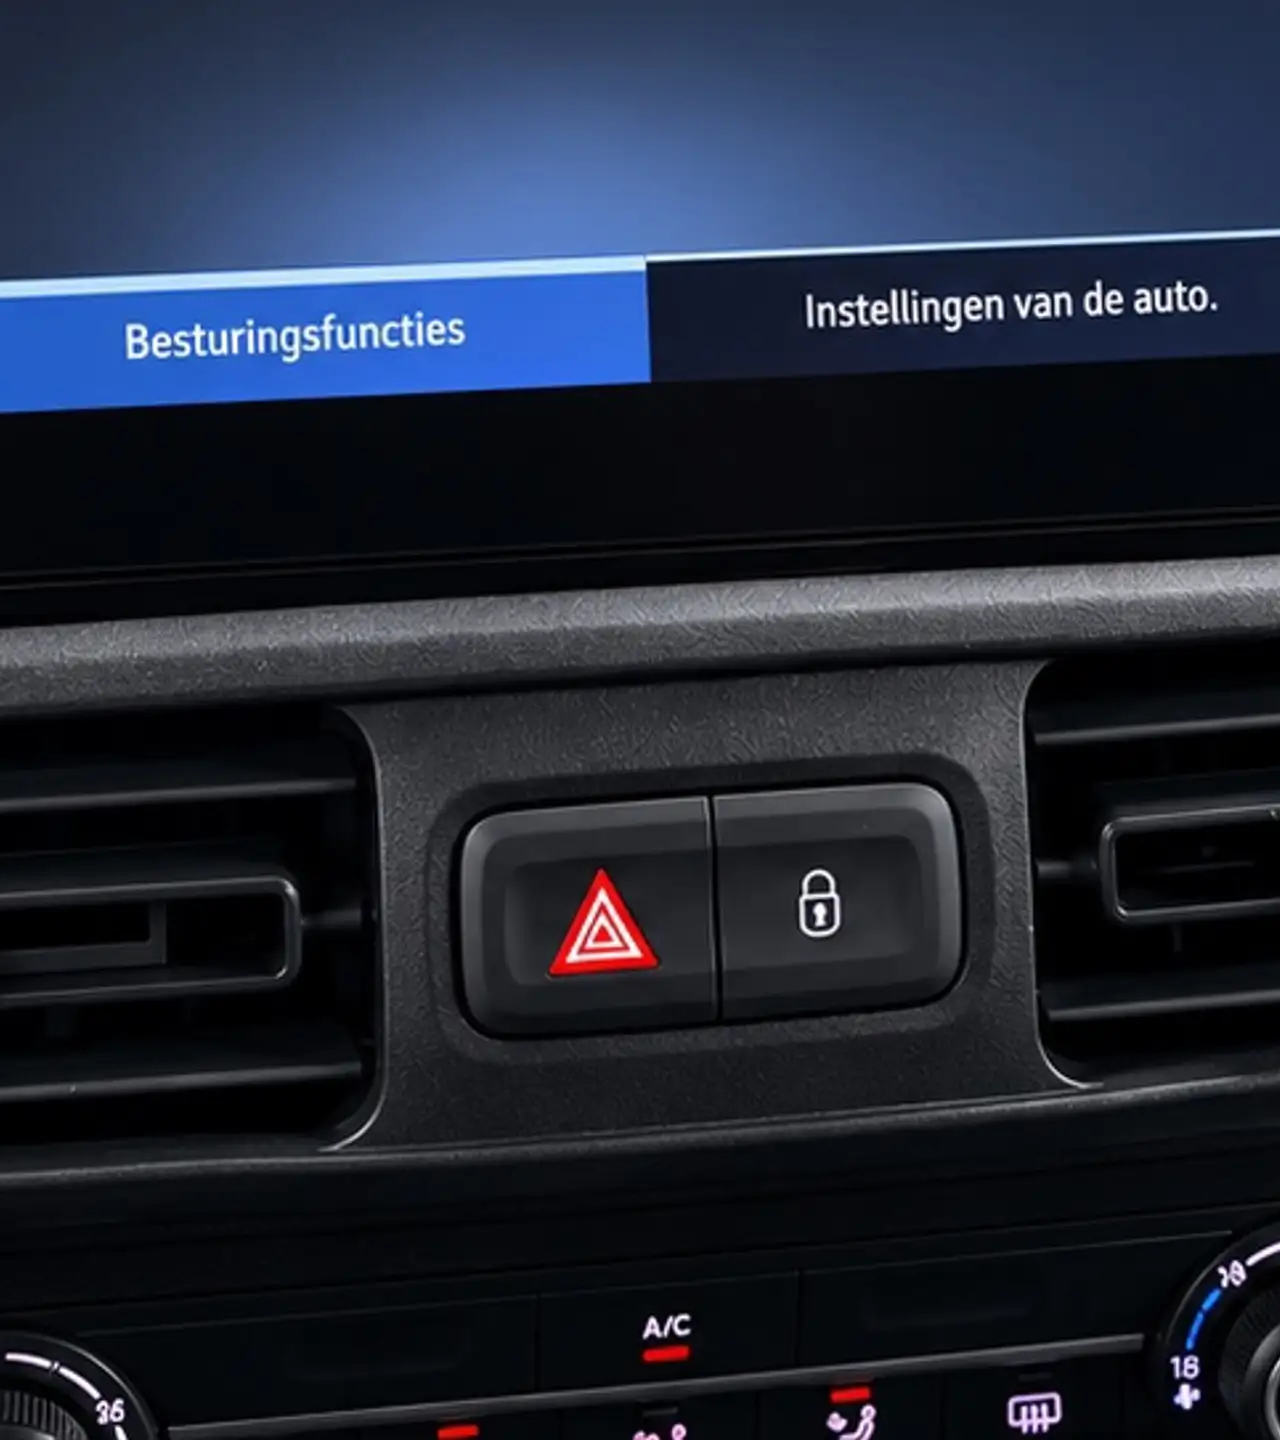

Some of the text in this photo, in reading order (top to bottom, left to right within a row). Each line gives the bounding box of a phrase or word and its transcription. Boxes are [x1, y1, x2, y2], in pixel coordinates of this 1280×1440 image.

[805, 280, 1219, 334] Instellingen van de auto.
[124, 311, 467, 364] Besturingsfuncties
[642, 1313, 692, 1340] A/C
